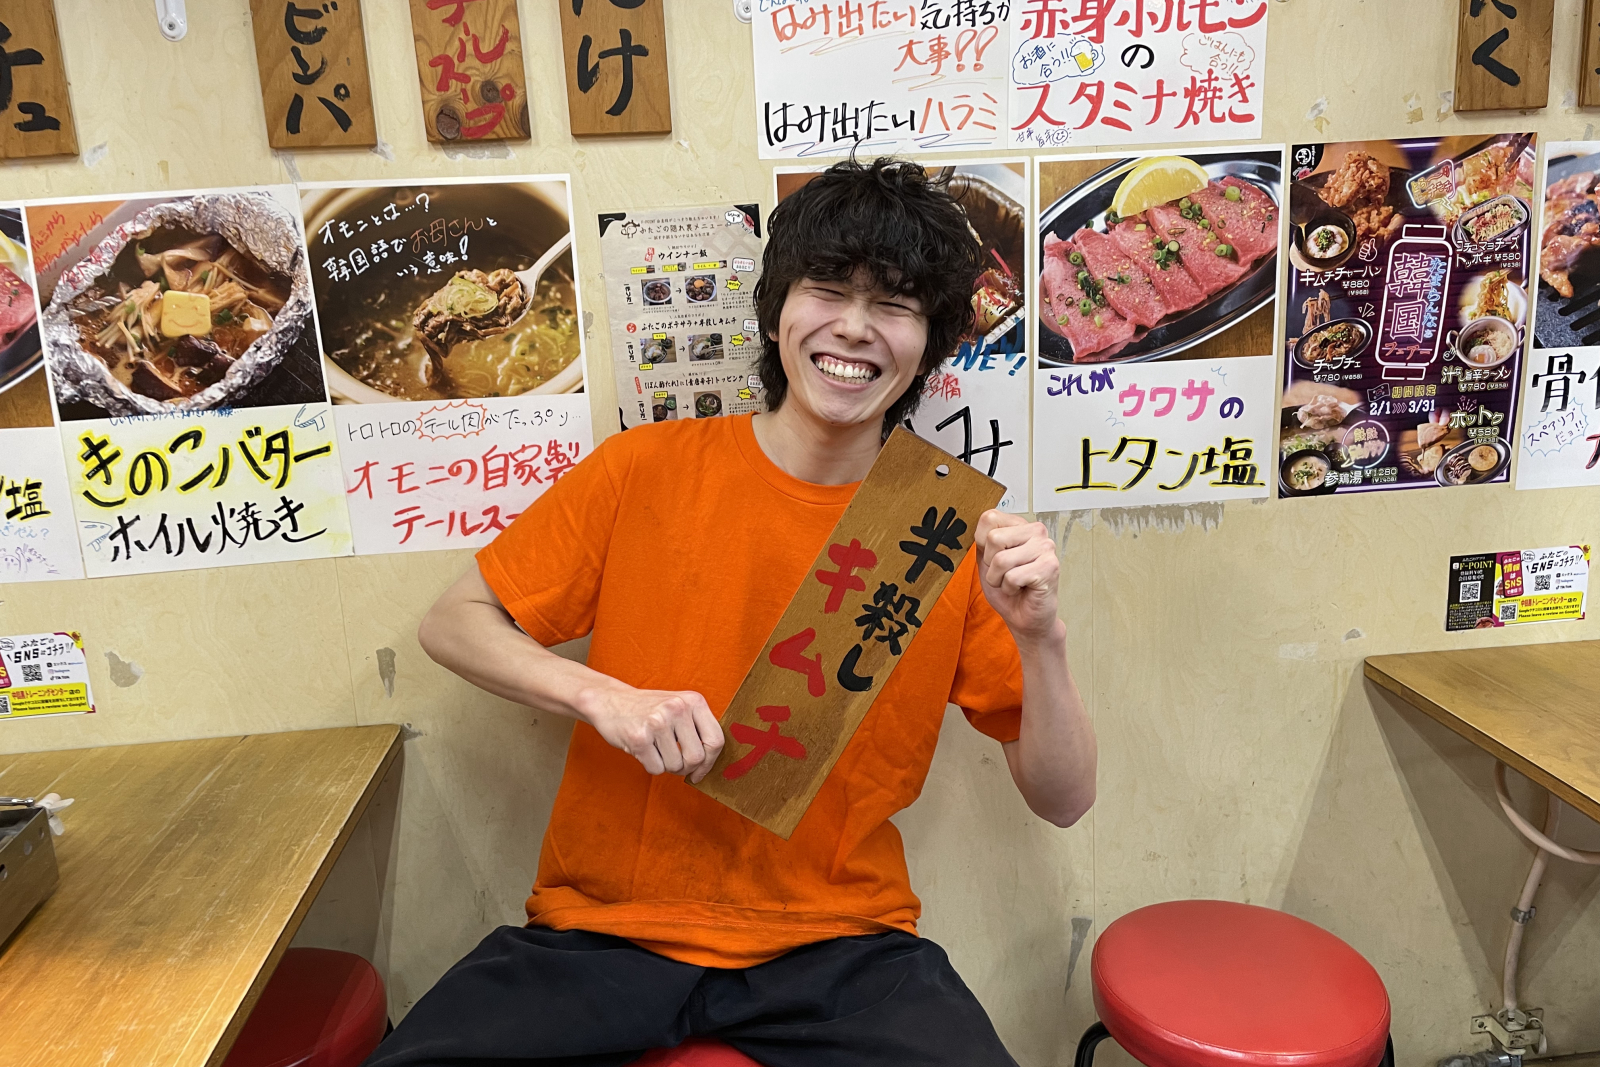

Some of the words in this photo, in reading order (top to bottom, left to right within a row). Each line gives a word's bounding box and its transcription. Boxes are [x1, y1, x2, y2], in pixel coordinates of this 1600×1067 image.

[571, 0, 649, 117] け
[1019, 41, 1056, 69] お酒に
[1120, 43, 1155, 69] の
[1010, 68, 1257, 132] スタミナ焼き
[1456, 235, 1520, 252] コチュマヨチーズ
[1456, 252, 1493, 268] トッポギ
[1494, 252, 1521, 262] ¥580
[1300, 266, 1383, 287] キムチチャーハン
[1342, 279, 1370, 290] ¥880
[1312, 354, 1362, 375] チャプチェ
[1313, 373, 1341, 383] ¥780
[1047, 368, 1117, 397] これが
[1118, 378, 1245, 422] ウワサの
[1391, 385, 1437, 399] 期間限定
[1370, 402, 1391, 416] 2/1
[1408, 399, 1435, 414] 3/31
[1448, 404, 1504, 429] ホットク
[82, 425, 332, 508] きのこバター
[346, 439, 581, 500] オモニの自家製
[1055, 437, 1266, 493] 上タン塩
[1324, 470, 1363, 487] 参鶏湯
[0, 476, 51, 521] 塩
[110, 495, 328, 563] ホイル焼き
[1460, 560, 1494, 570] F-POINT
[1504, 576, 1522, 590] SNS
[837, 505, 968, 692] 半殺し
[722, 537, 878, 781] キムチ
